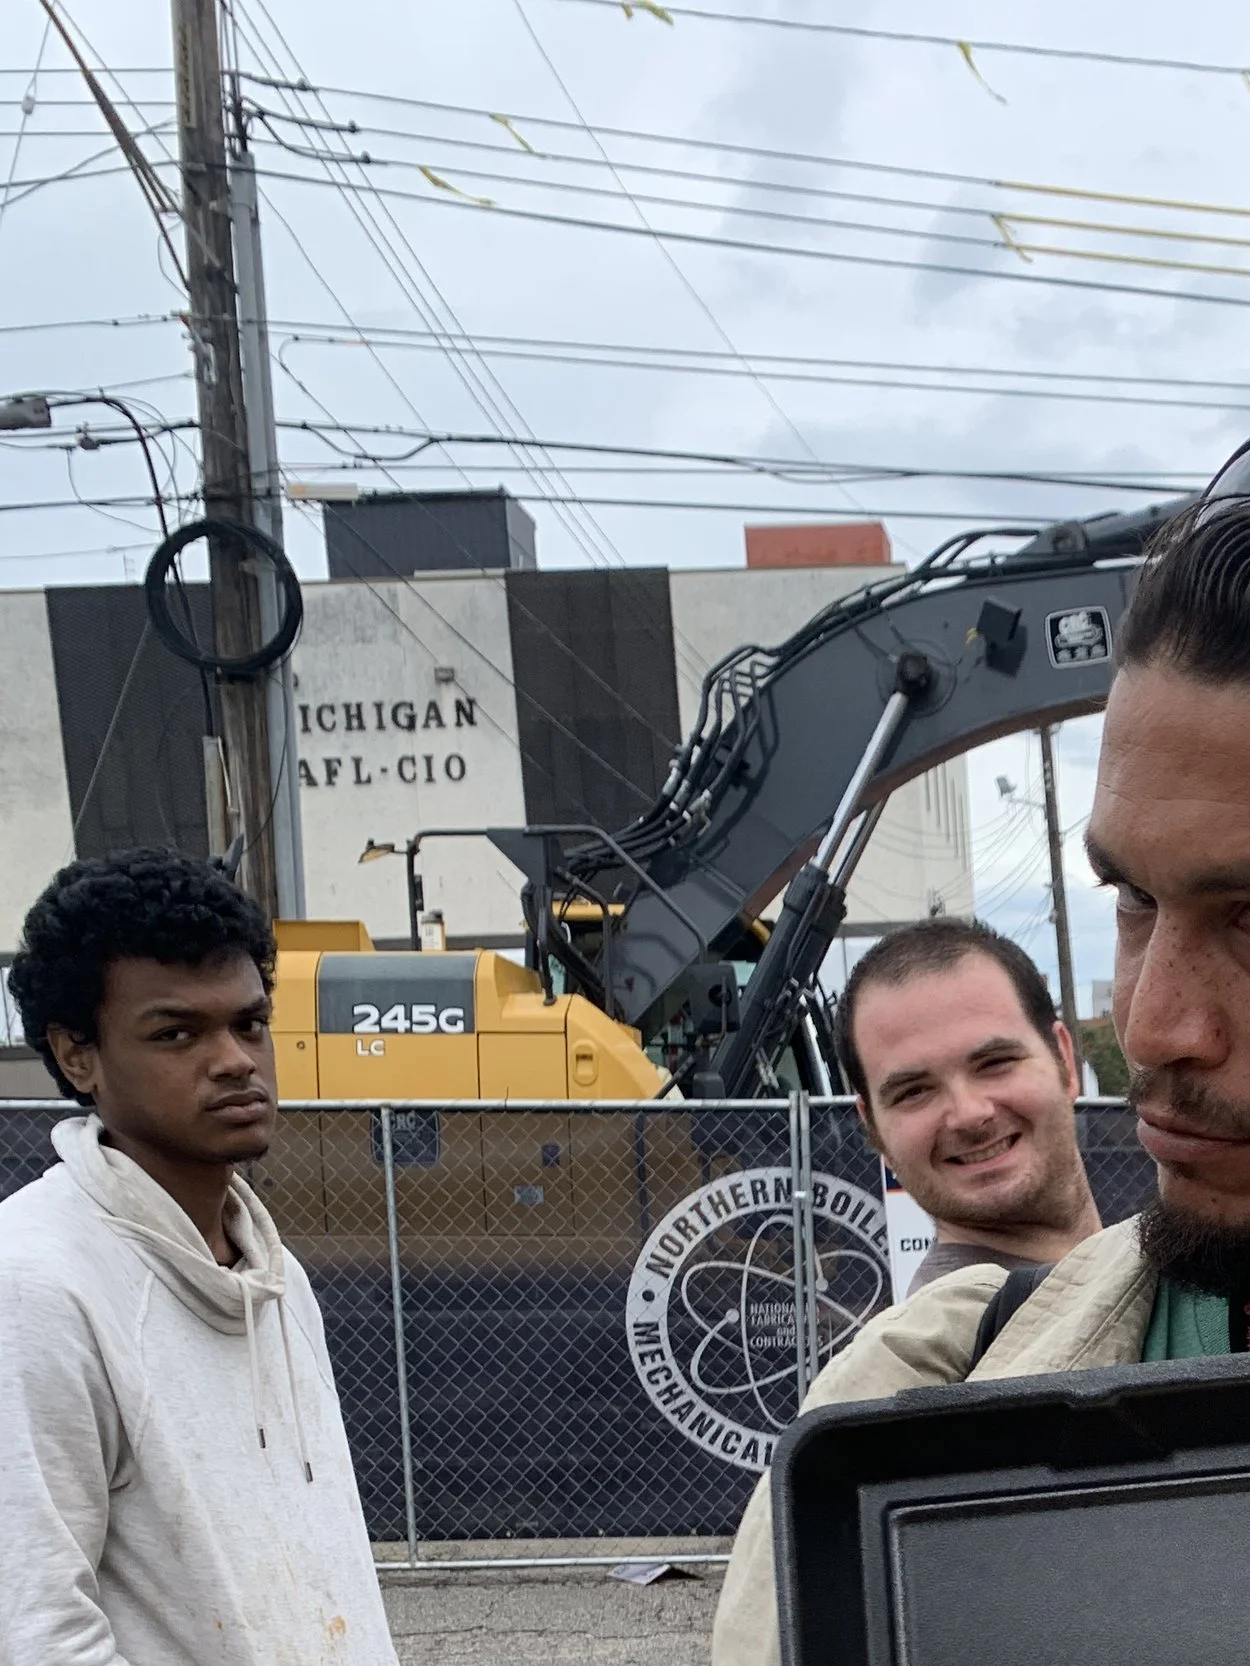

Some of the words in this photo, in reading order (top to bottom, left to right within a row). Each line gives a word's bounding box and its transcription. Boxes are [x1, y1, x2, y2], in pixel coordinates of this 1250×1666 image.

[298, 697, 478, 733] ICHIGAN
[298, 753, 467, 787] AFL-CIO
[353, 1003, 465, 1033] 245G
[356, 1039, 385, 1056] LC
[645, 1177, 793, 1279] NORTHERN
[812, 1182, 889, 1256] BOILE
[750, 1302, 796, 1314] NATIONA
